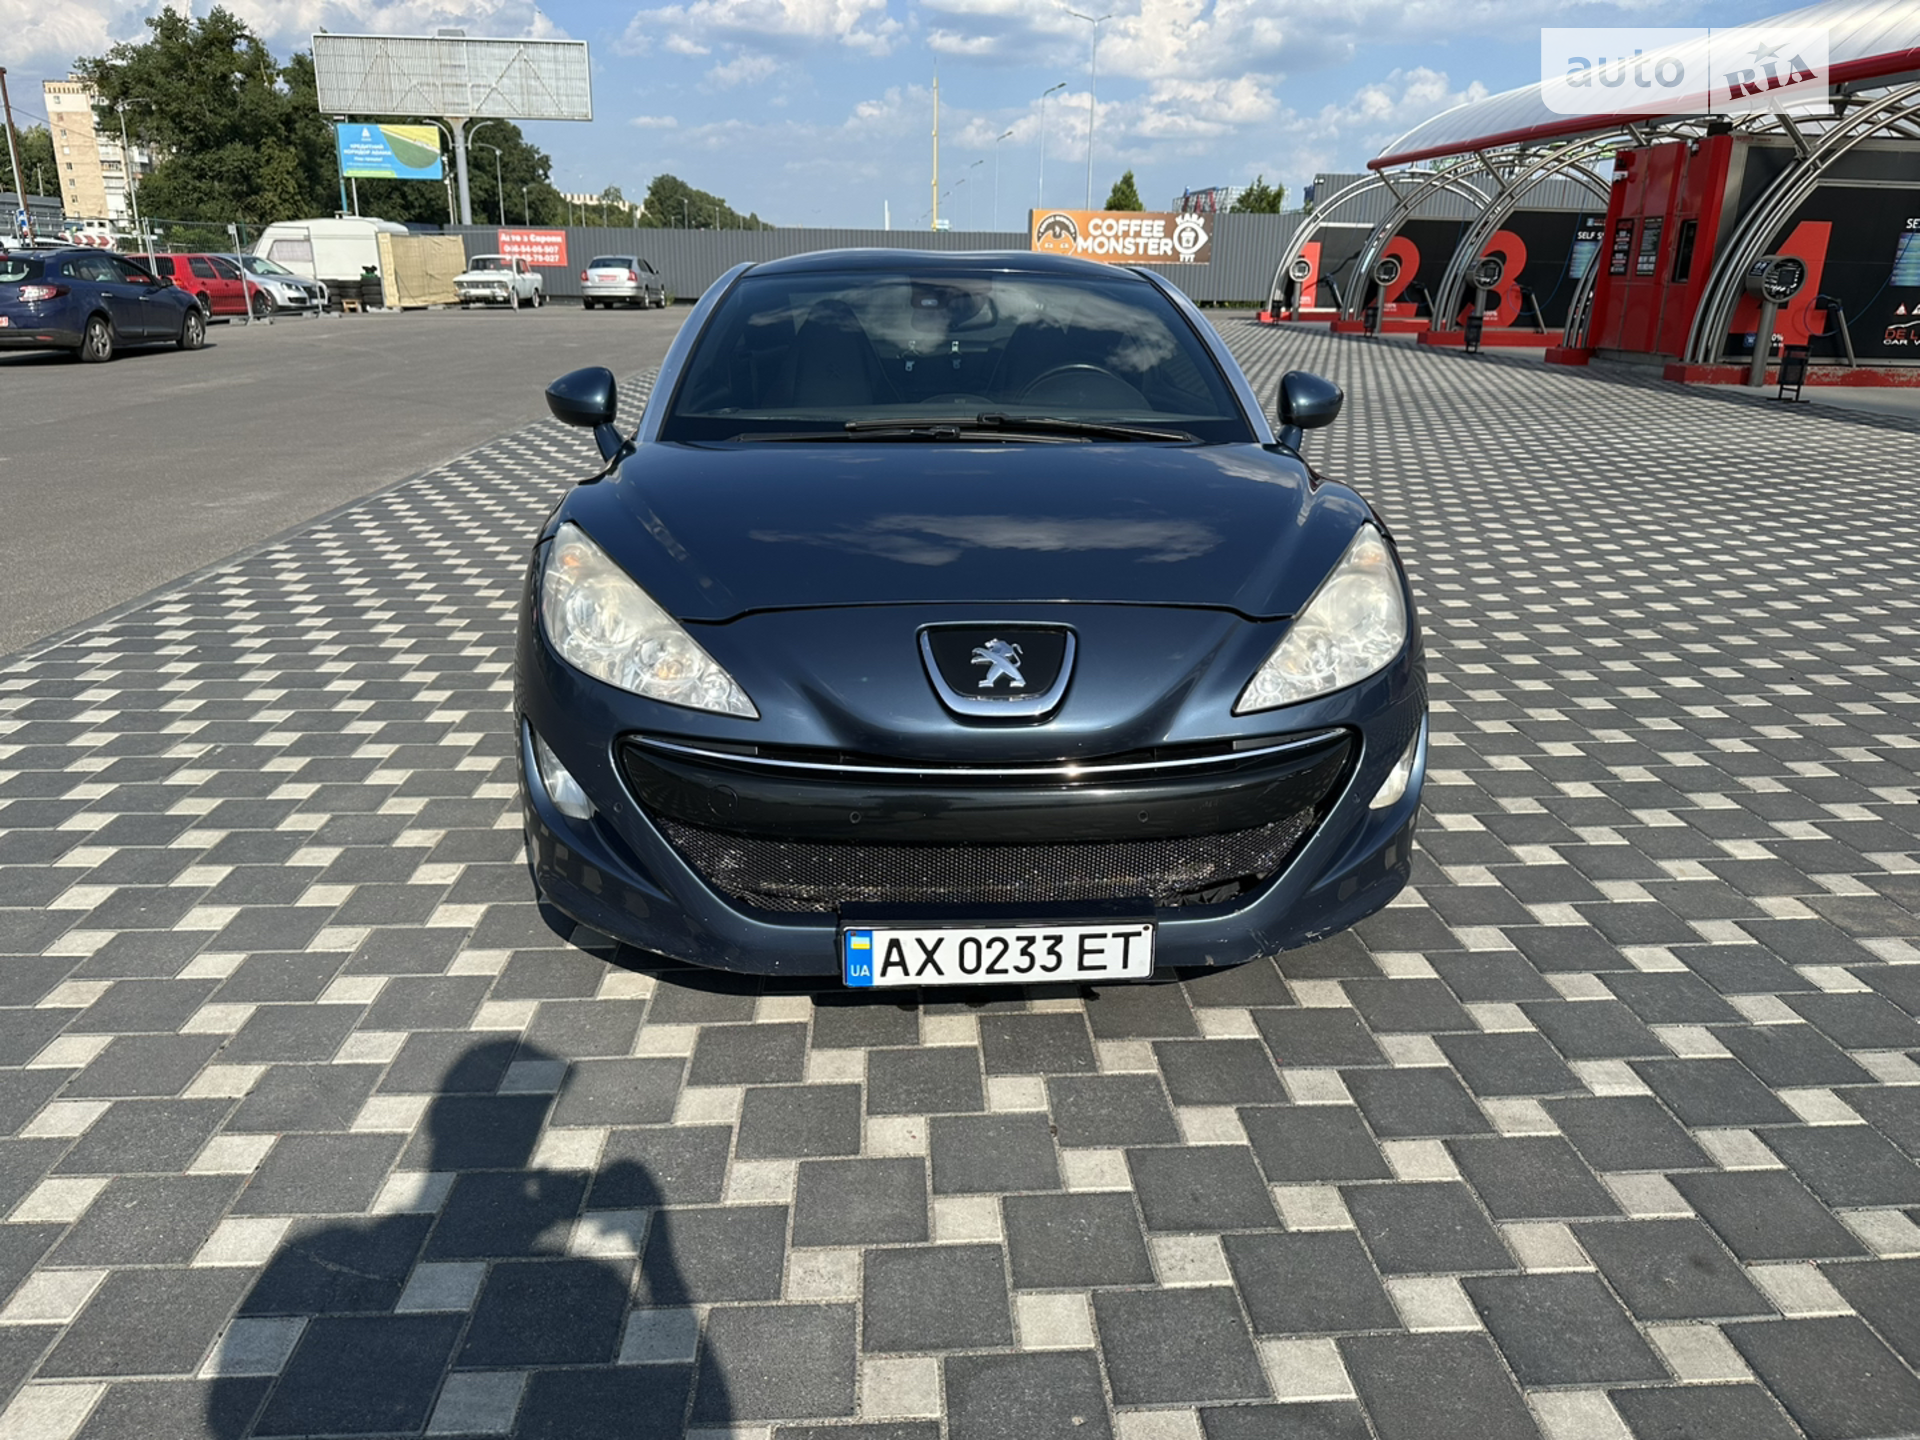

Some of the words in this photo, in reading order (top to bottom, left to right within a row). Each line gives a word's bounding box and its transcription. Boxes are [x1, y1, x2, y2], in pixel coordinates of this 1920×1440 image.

[1088, 218, 1165, 237] COFFEE
[1906, 218, 1920, 229] SE
[1577, 231, 1596, 239] SELF
[1076, 237, 1173, 256] MONSTER
[1366, 236, 1420, 317] 2
[1457, 230, 1527, 327] 3
[1729, 221, 1832, 357] 4
[880, 937, 945, 977] AX
[958, 934, 1063, 975] 0233
[1077, 931, 1142, 971] ET
[851, 964, 870, 977] UA
